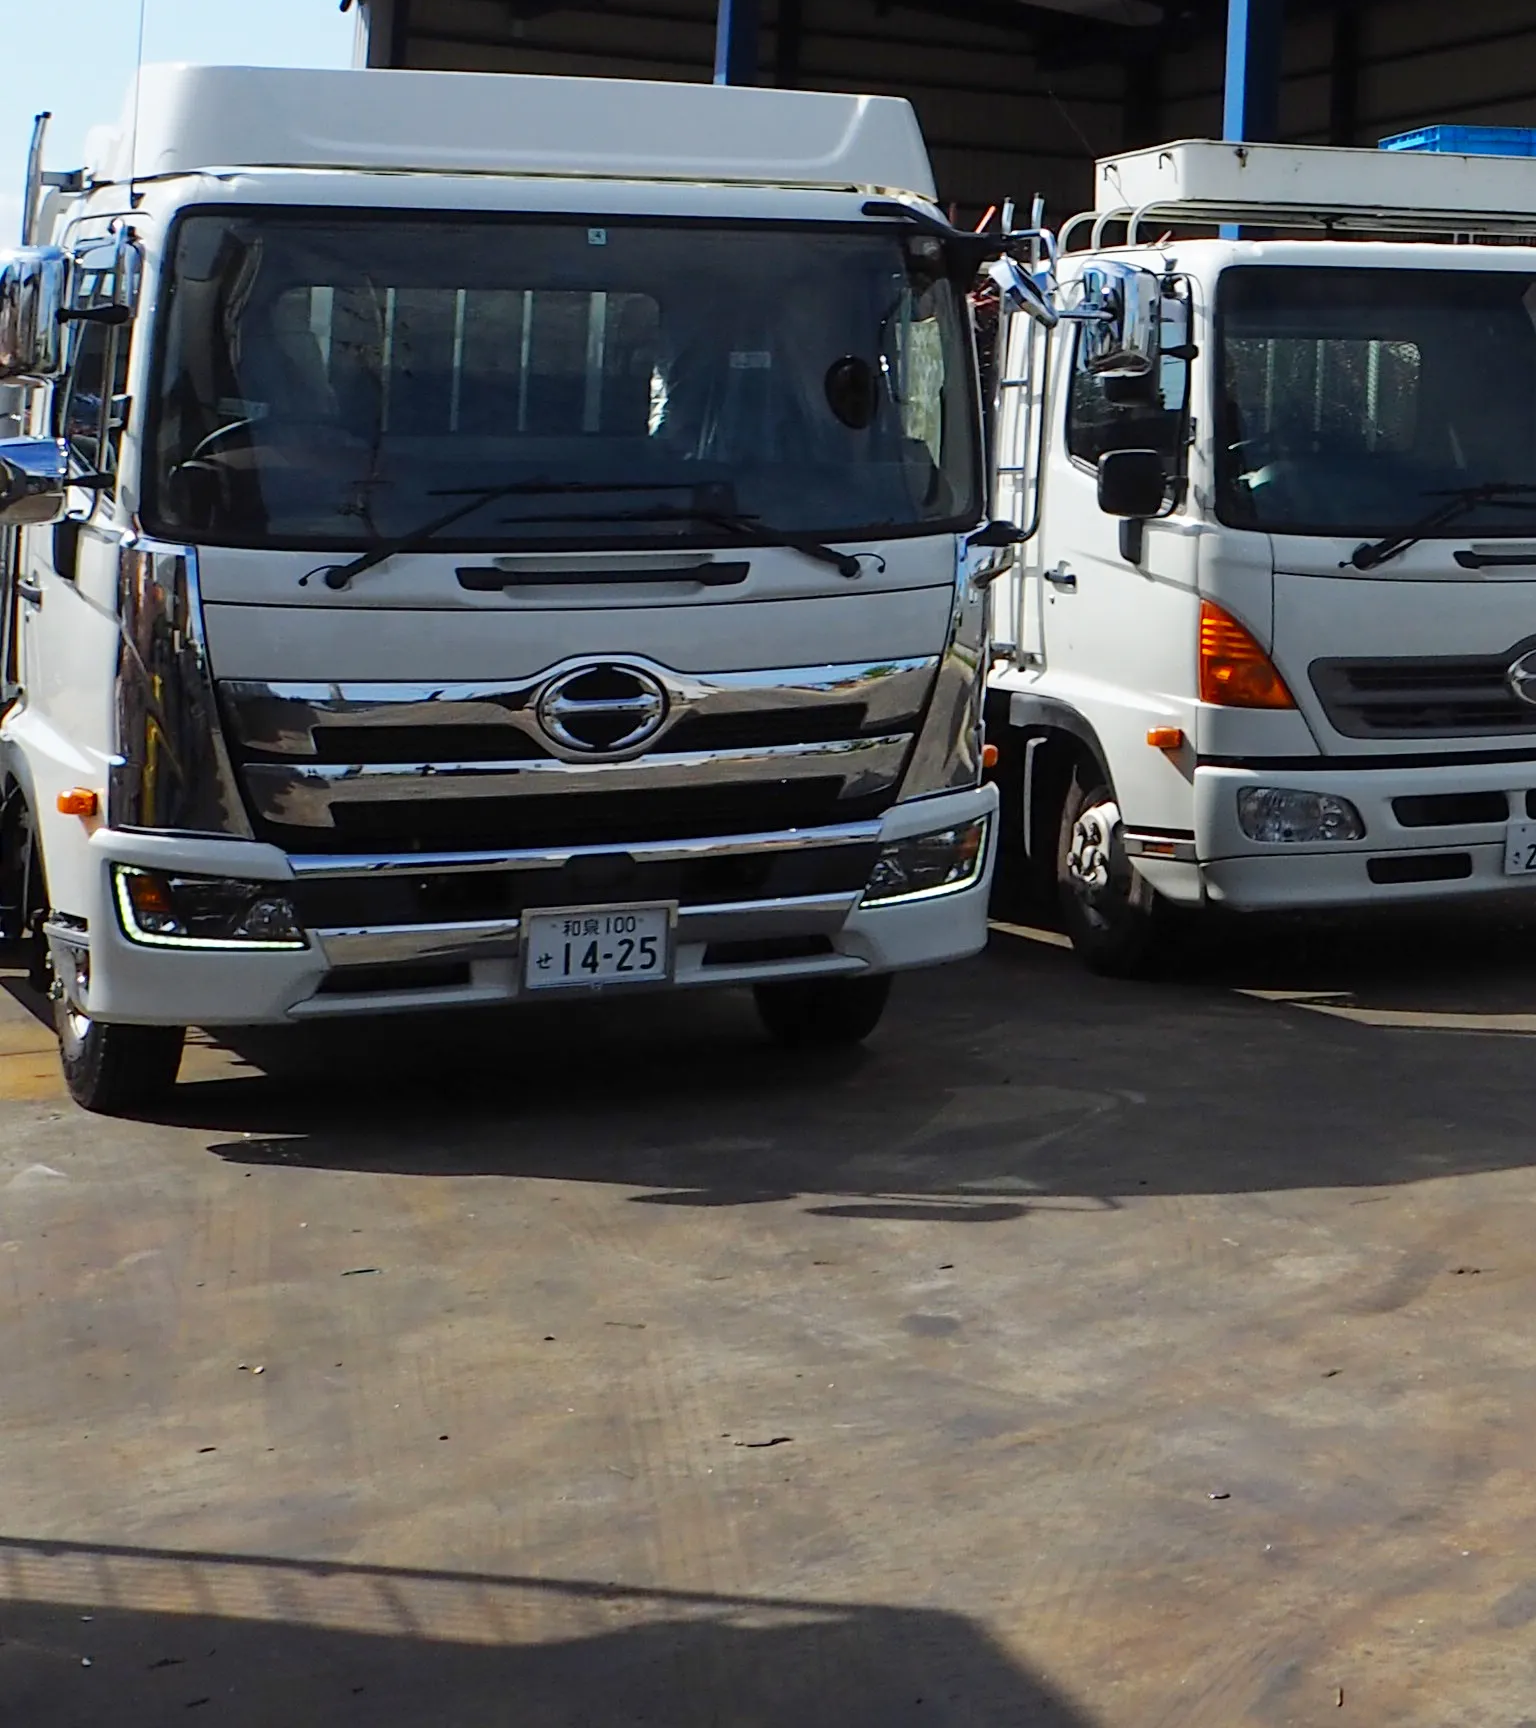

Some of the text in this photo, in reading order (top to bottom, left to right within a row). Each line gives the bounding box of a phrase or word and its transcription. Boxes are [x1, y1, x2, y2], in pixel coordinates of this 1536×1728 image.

[562, 915, 636, 937] 和泉 100
[536, 936, 658, 976] せ 14-25
